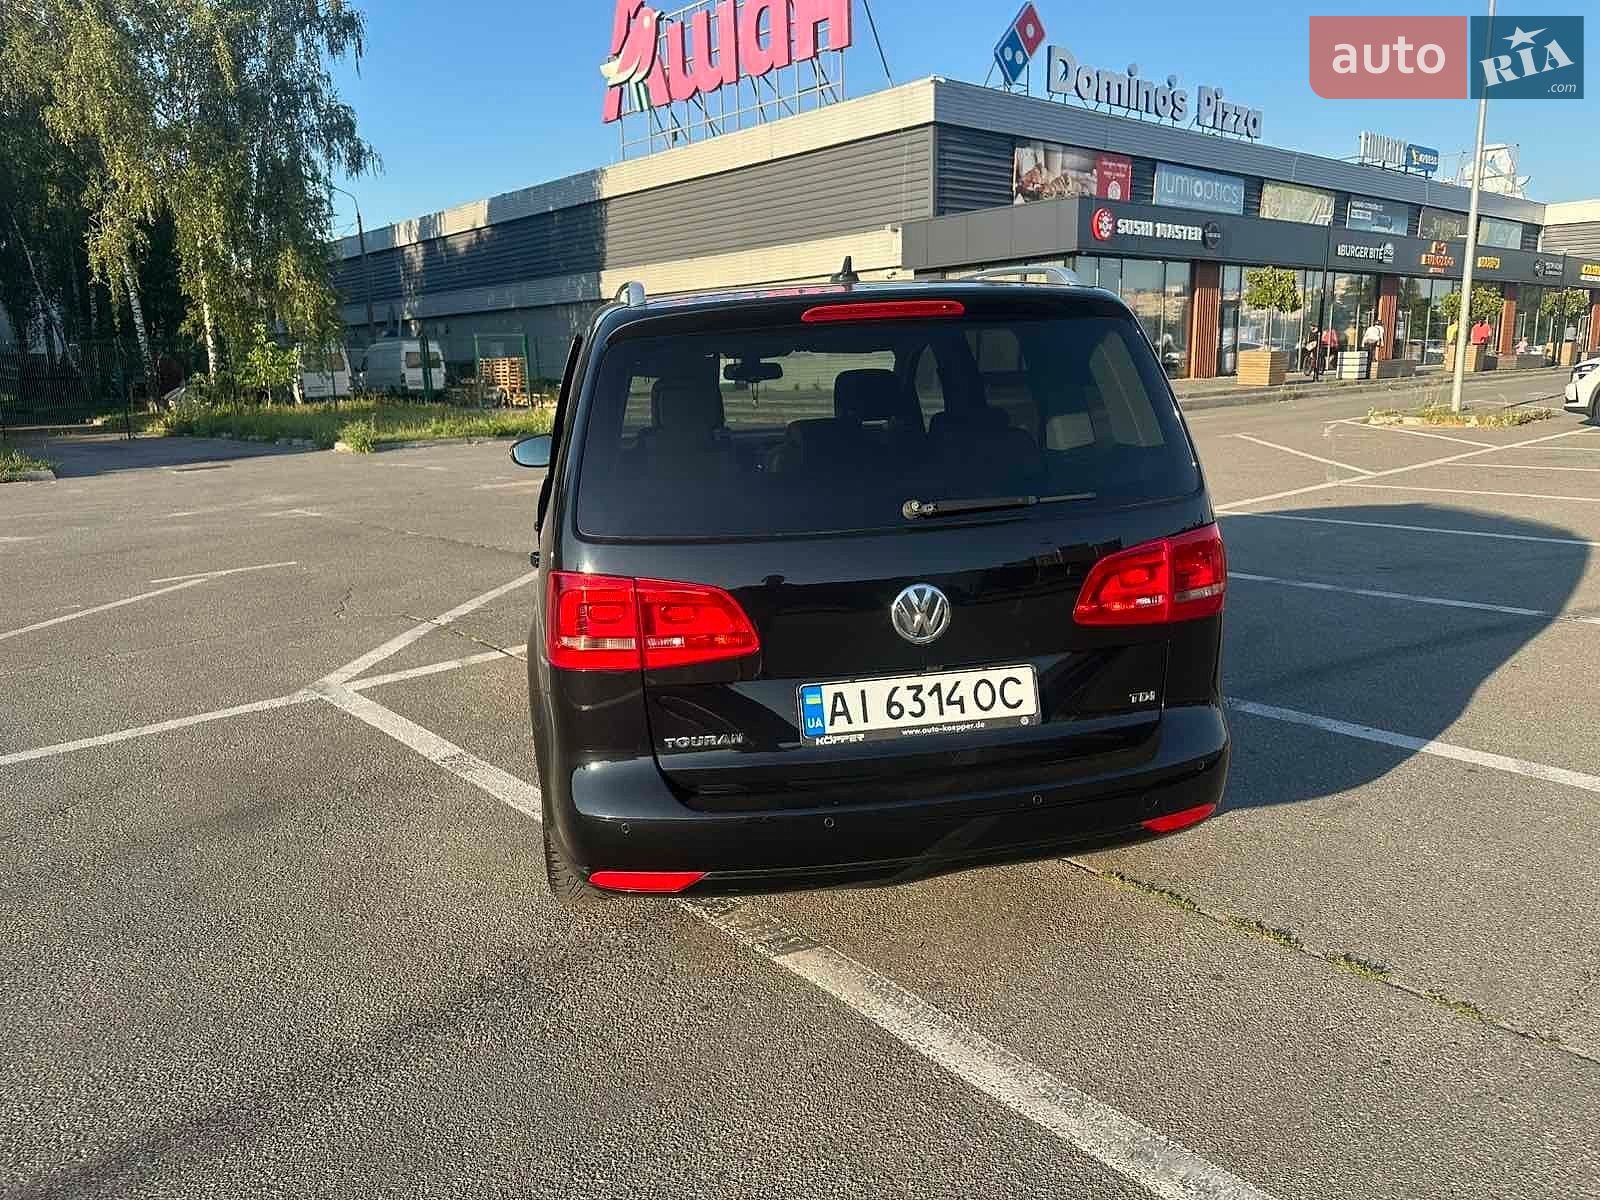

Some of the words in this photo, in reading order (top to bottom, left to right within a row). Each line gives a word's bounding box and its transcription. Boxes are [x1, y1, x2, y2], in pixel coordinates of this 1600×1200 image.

[1047, 45, 1188, 121] Domino's
[1197, 85, 1263, 138] Pizza
[1117, 218, 1153, 236] SUSHI
[1155, 222, 1202, 240] MASTER
[829, 689, 869, 727] AI
[886, 680, 966, 720] 6314
[973, 676, 1024, 712] OC
[807, 717, 824, 729] UA
[663, 733, 743, 748] TOURAN
